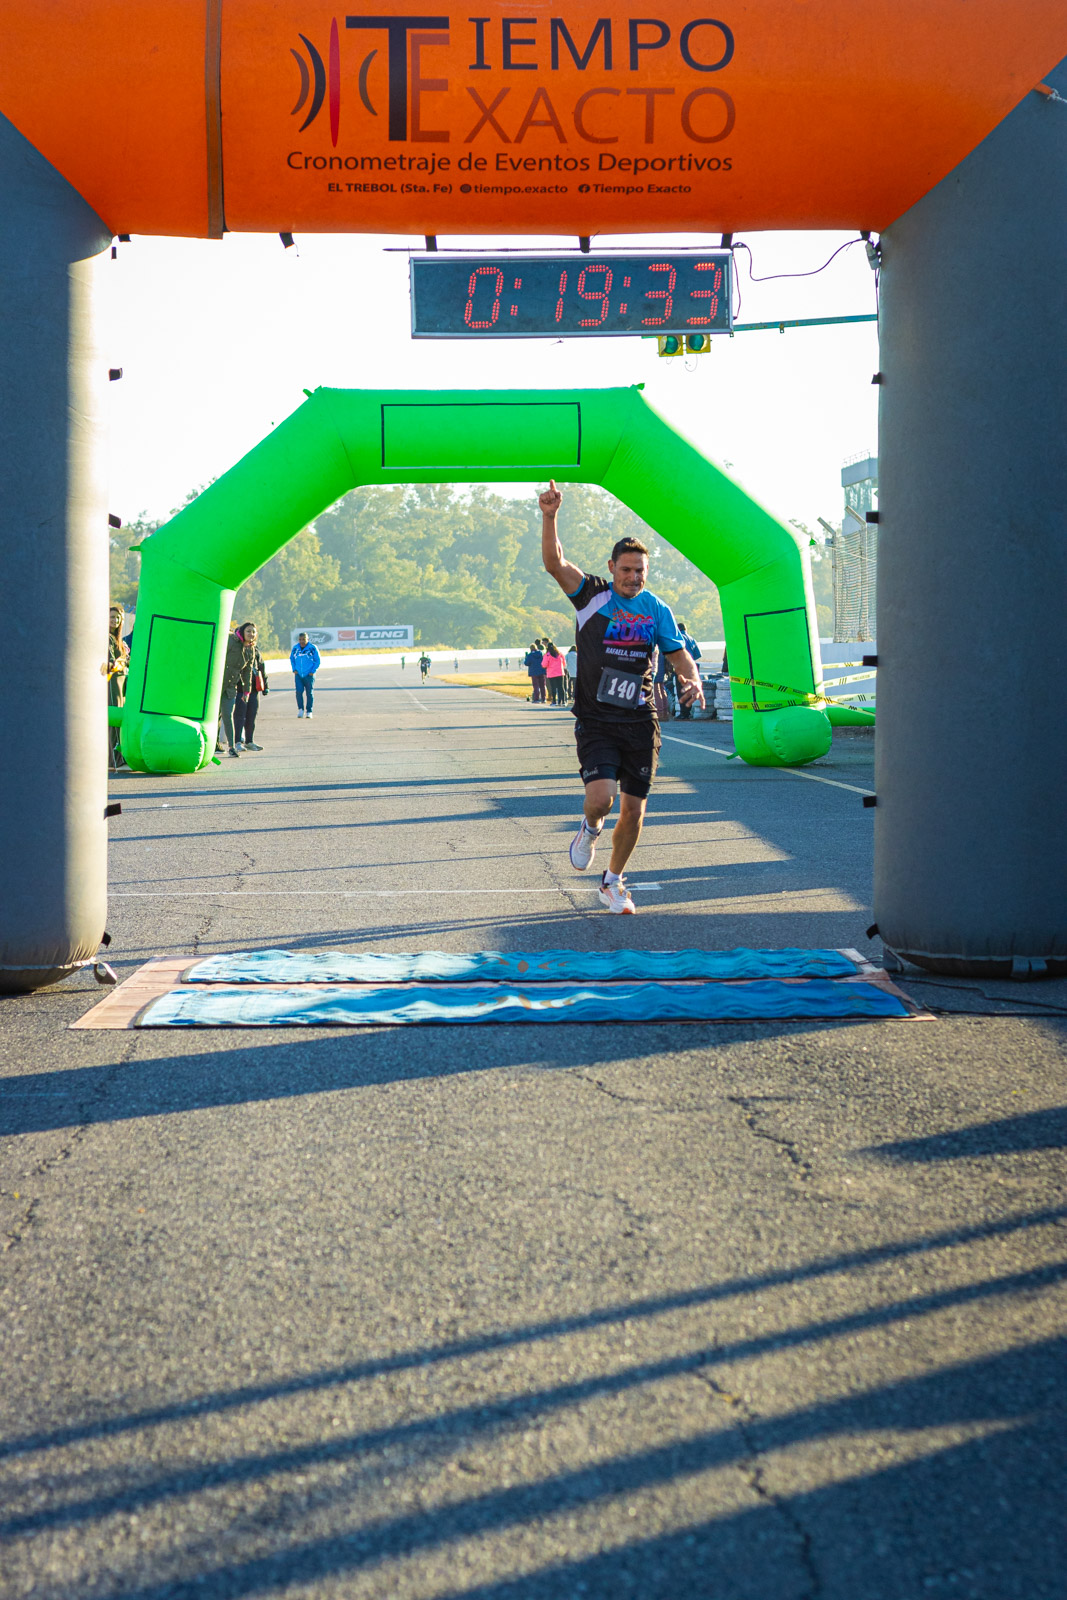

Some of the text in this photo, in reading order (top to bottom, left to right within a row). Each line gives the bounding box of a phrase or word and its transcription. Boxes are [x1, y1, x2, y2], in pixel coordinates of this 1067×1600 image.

[286, 151, 733, 176] Cronometraje de Eventos Deportivos
[327, 182, 692, 196] EL TREBOL (Sta. Fe) tiempo.exacto Tiempo Exacto
[464, 262, 722, 329] 0:19:33
[359, 630, 405, 639] LONG
[607, 677, 636, 700] 140
